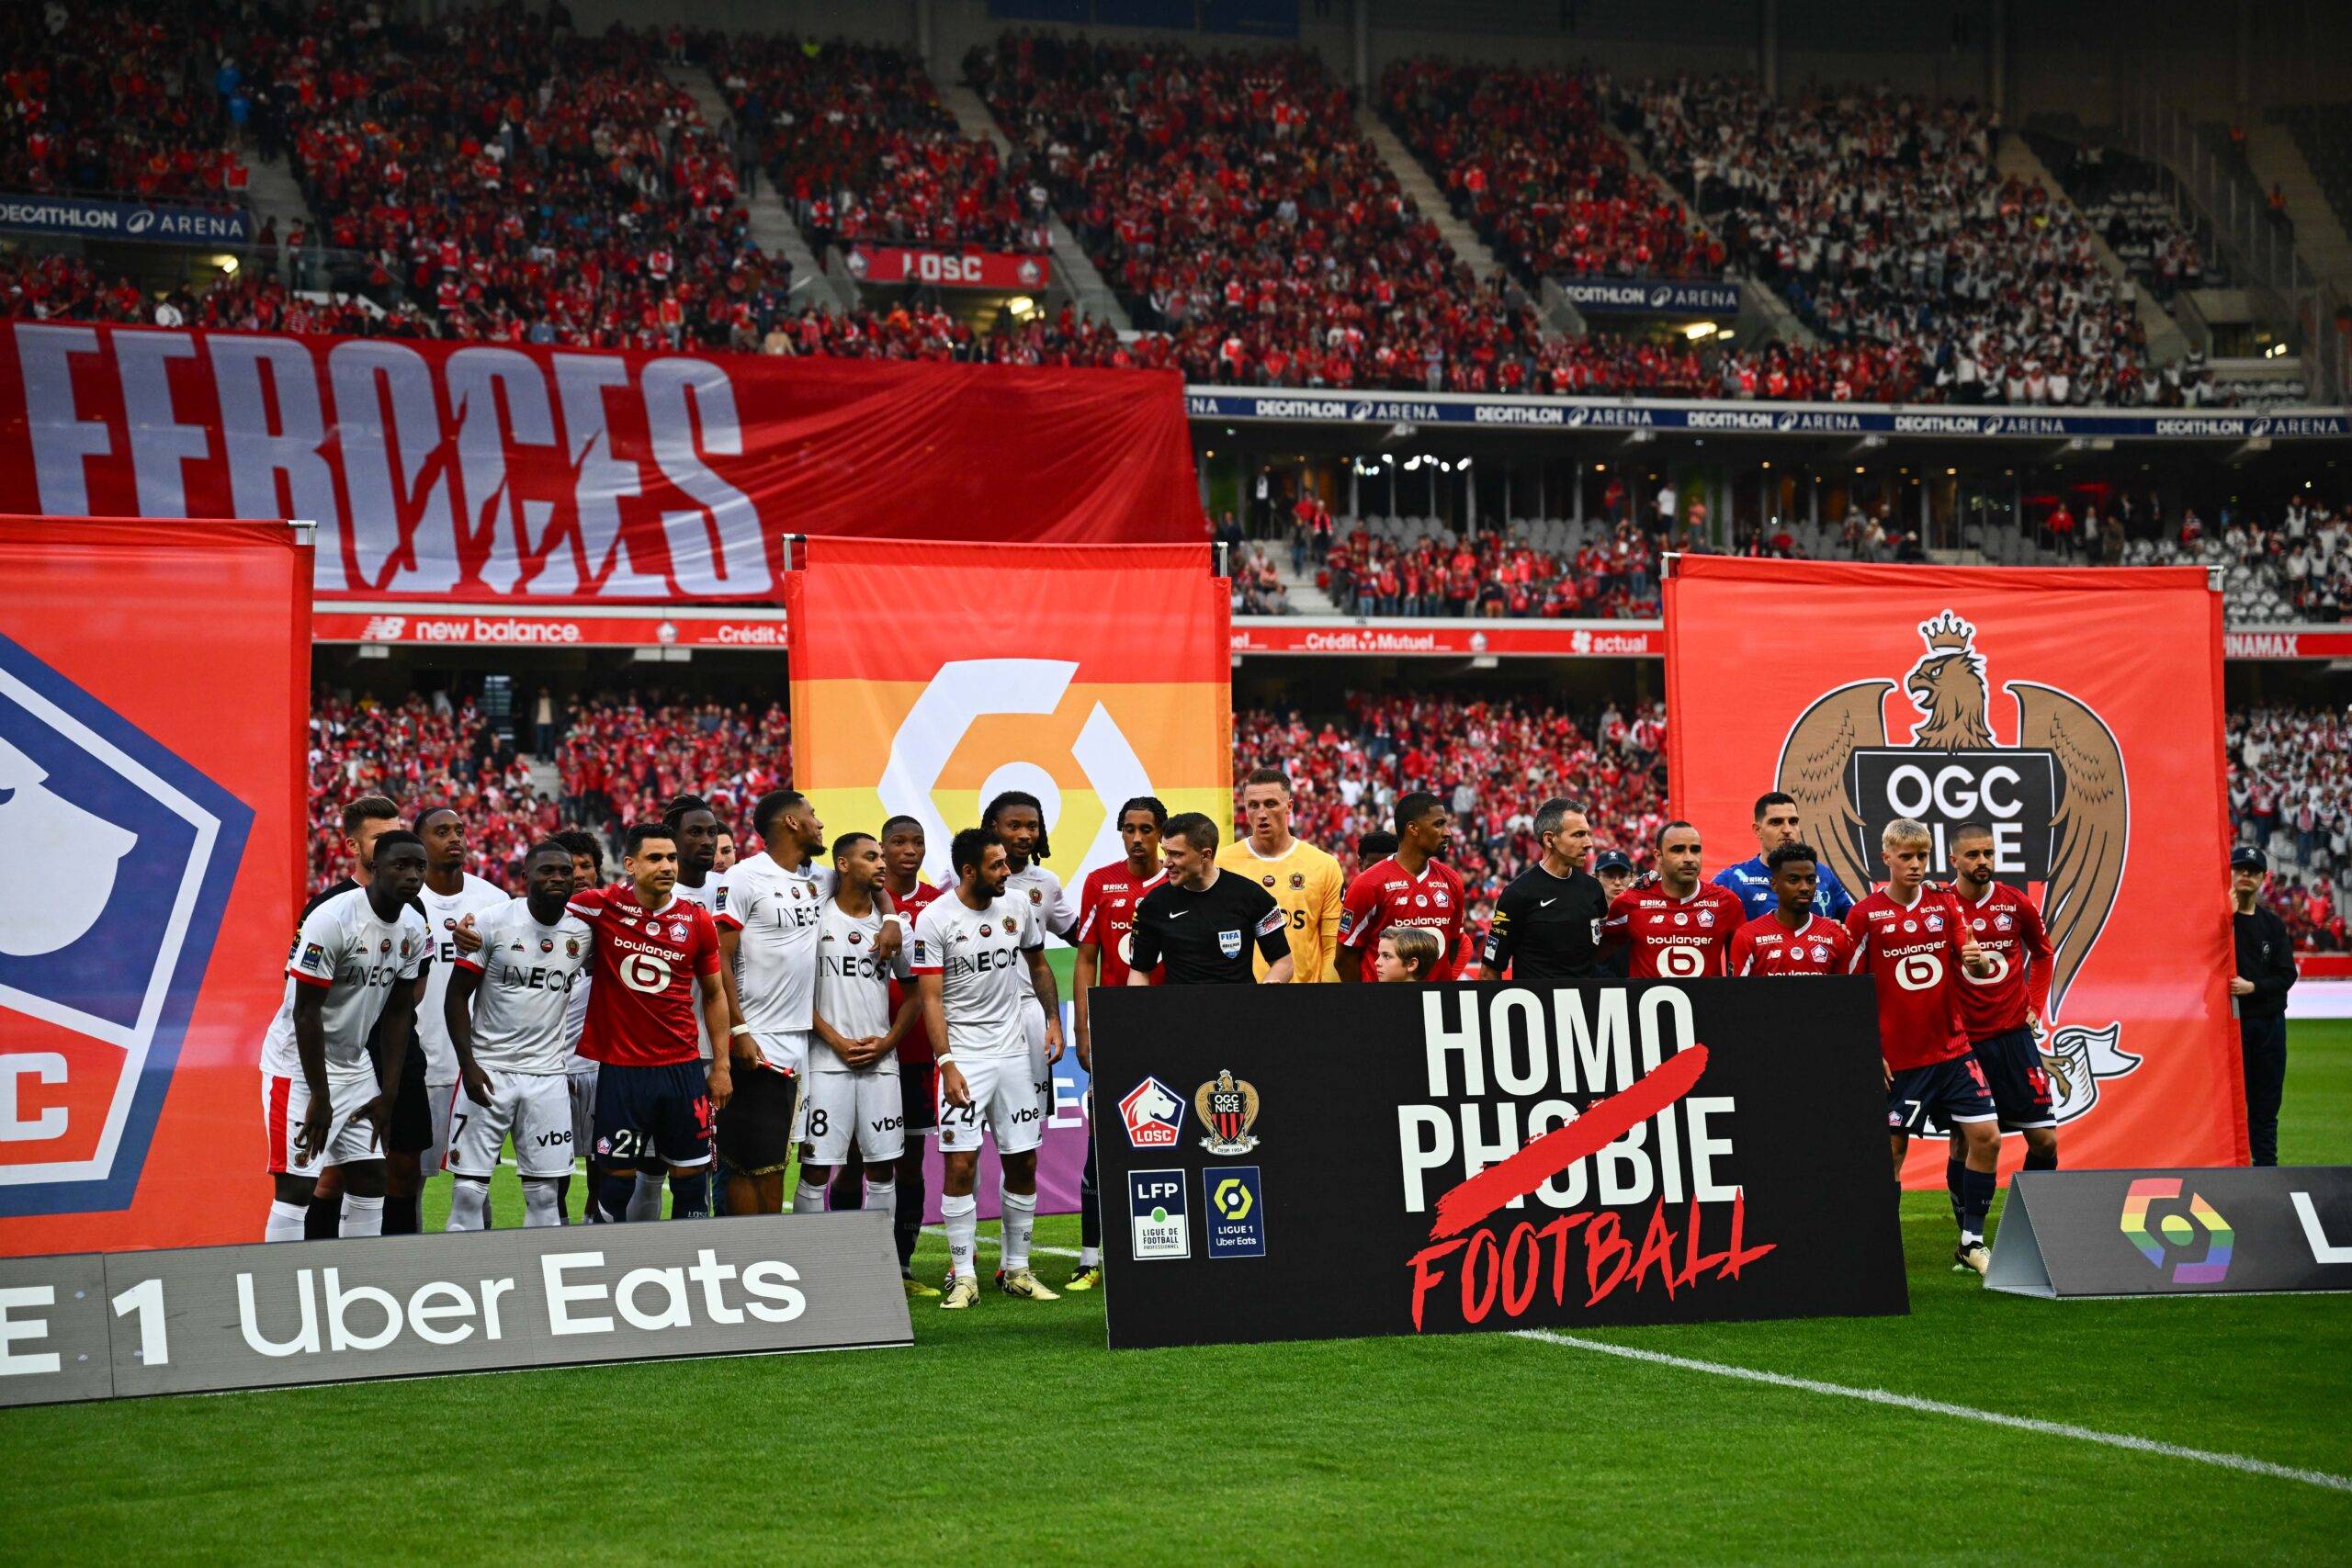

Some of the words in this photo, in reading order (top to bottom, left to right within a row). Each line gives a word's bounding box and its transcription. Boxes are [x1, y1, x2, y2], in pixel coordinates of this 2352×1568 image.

[0, 204, 118, 230] DECATHLON
[160, 215, 243, 237] ARENA
[1674, 289, 1738, 306] ARENA
[1256, 400, 1346, 418] DECATHLON
[1376, 403, 1440, 421] ARENA
[1475, 406, 1563, 424] DECATHLON
[1591, 409, 1653, 426] ARENA
[1688, 412, 1772, 429] DECATHLON
[1801, 413, 1860, 430] ARENA
[1894, 415, 1979, 432] DECATHLON
[2007, 417, 2065, 434] ARENA
[2155, 420, 2244, 434] DECATHLON
[2274, 418, 2340, 434] ARENA
[416, 622, 469, 640] new
[474, 618, 580, 642] balance
[718, 625, 775, 643] Crédit
[1306, 633, 1357, 650] Crédit
[1378, 632, 1435, 650] Mutuel
[1594, 634, 1647, 653] actual
[2224, 634, 2298, 657] INAMAX
[1886, 764, 2024, 819] OGC
[1989, 904, 2017, 912] actual
[1395, 916, 1451, 927] boulanger
[1220, 932, 1239, 941] FIFA
[1646, 934, 1713, 946] boulanger
[1807, 934, 1833, 944] actual
[1978, 939, 2014, 951] anger
[614, 936, 686, 962] boulanger
[1883, 939, 1947, 958] boulanger
[503, 966, 576, 994] INEOS
[1422, 985, 1696, 1098] HOMO
[1214, 1094, 1239, 1104] OGC
[1012, 1105, 1040, 1125] vbe
[1215, 1104, 1240, 1113] NICE
[1905, 1100, 1921, 1128] 7
[451, 1112, 469, 1145] 7
[871, 1116, 904, 1133] vbe
[537, 1130, 573, 1147] vbe
[1136, 1129, 1172, 1143] LOSC
[1397, 1096, 1745, 1213] PHOBIE
[1137, 1183, 1179, 1200] LFP
[1143, 1228, 1166, 1236] LIGUE
[1169, 1227, 1179, 1235] DE
[1218, 1226, 1247, 1235] LIGUE
[1249, 1225, 1253, 1234] 1
[1143, 1235, 1179, 1245] FOOTBALL
[1216, 1237, 1236, 1247] Uber
[1237, 1236, 1257, 1246] Eats
[1406, 1185, 1778, 1333] FOOTBALL
[112, 1279, 170, 1366] 1
[237, 1268, 514, 1358] Uber
[540, 1248, 807, 1337] Eats
